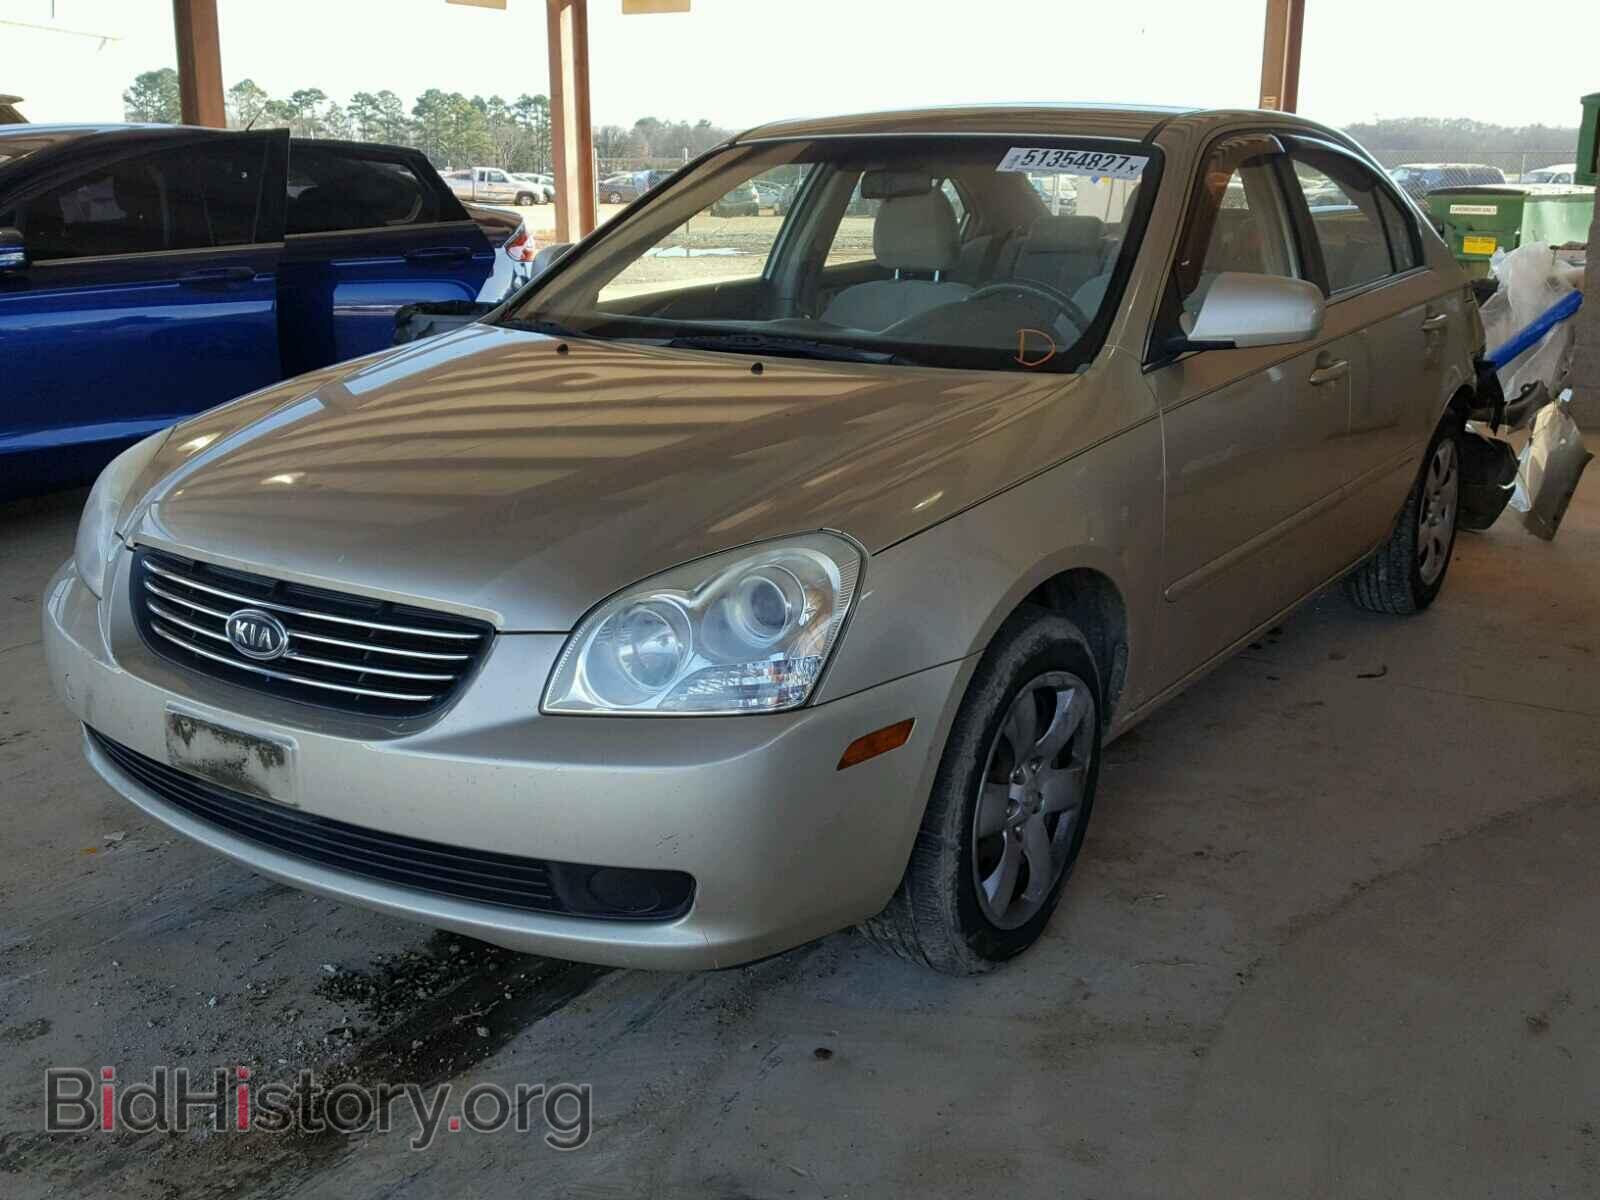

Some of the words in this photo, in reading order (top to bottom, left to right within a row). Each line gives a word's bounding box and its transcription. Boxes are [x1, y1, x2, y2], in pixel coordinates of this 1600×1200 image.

[1021, 149, 1131, 172] 51354827
[1013, 328, 1056, 366] D
[235, 619, 273, 650] KIA
